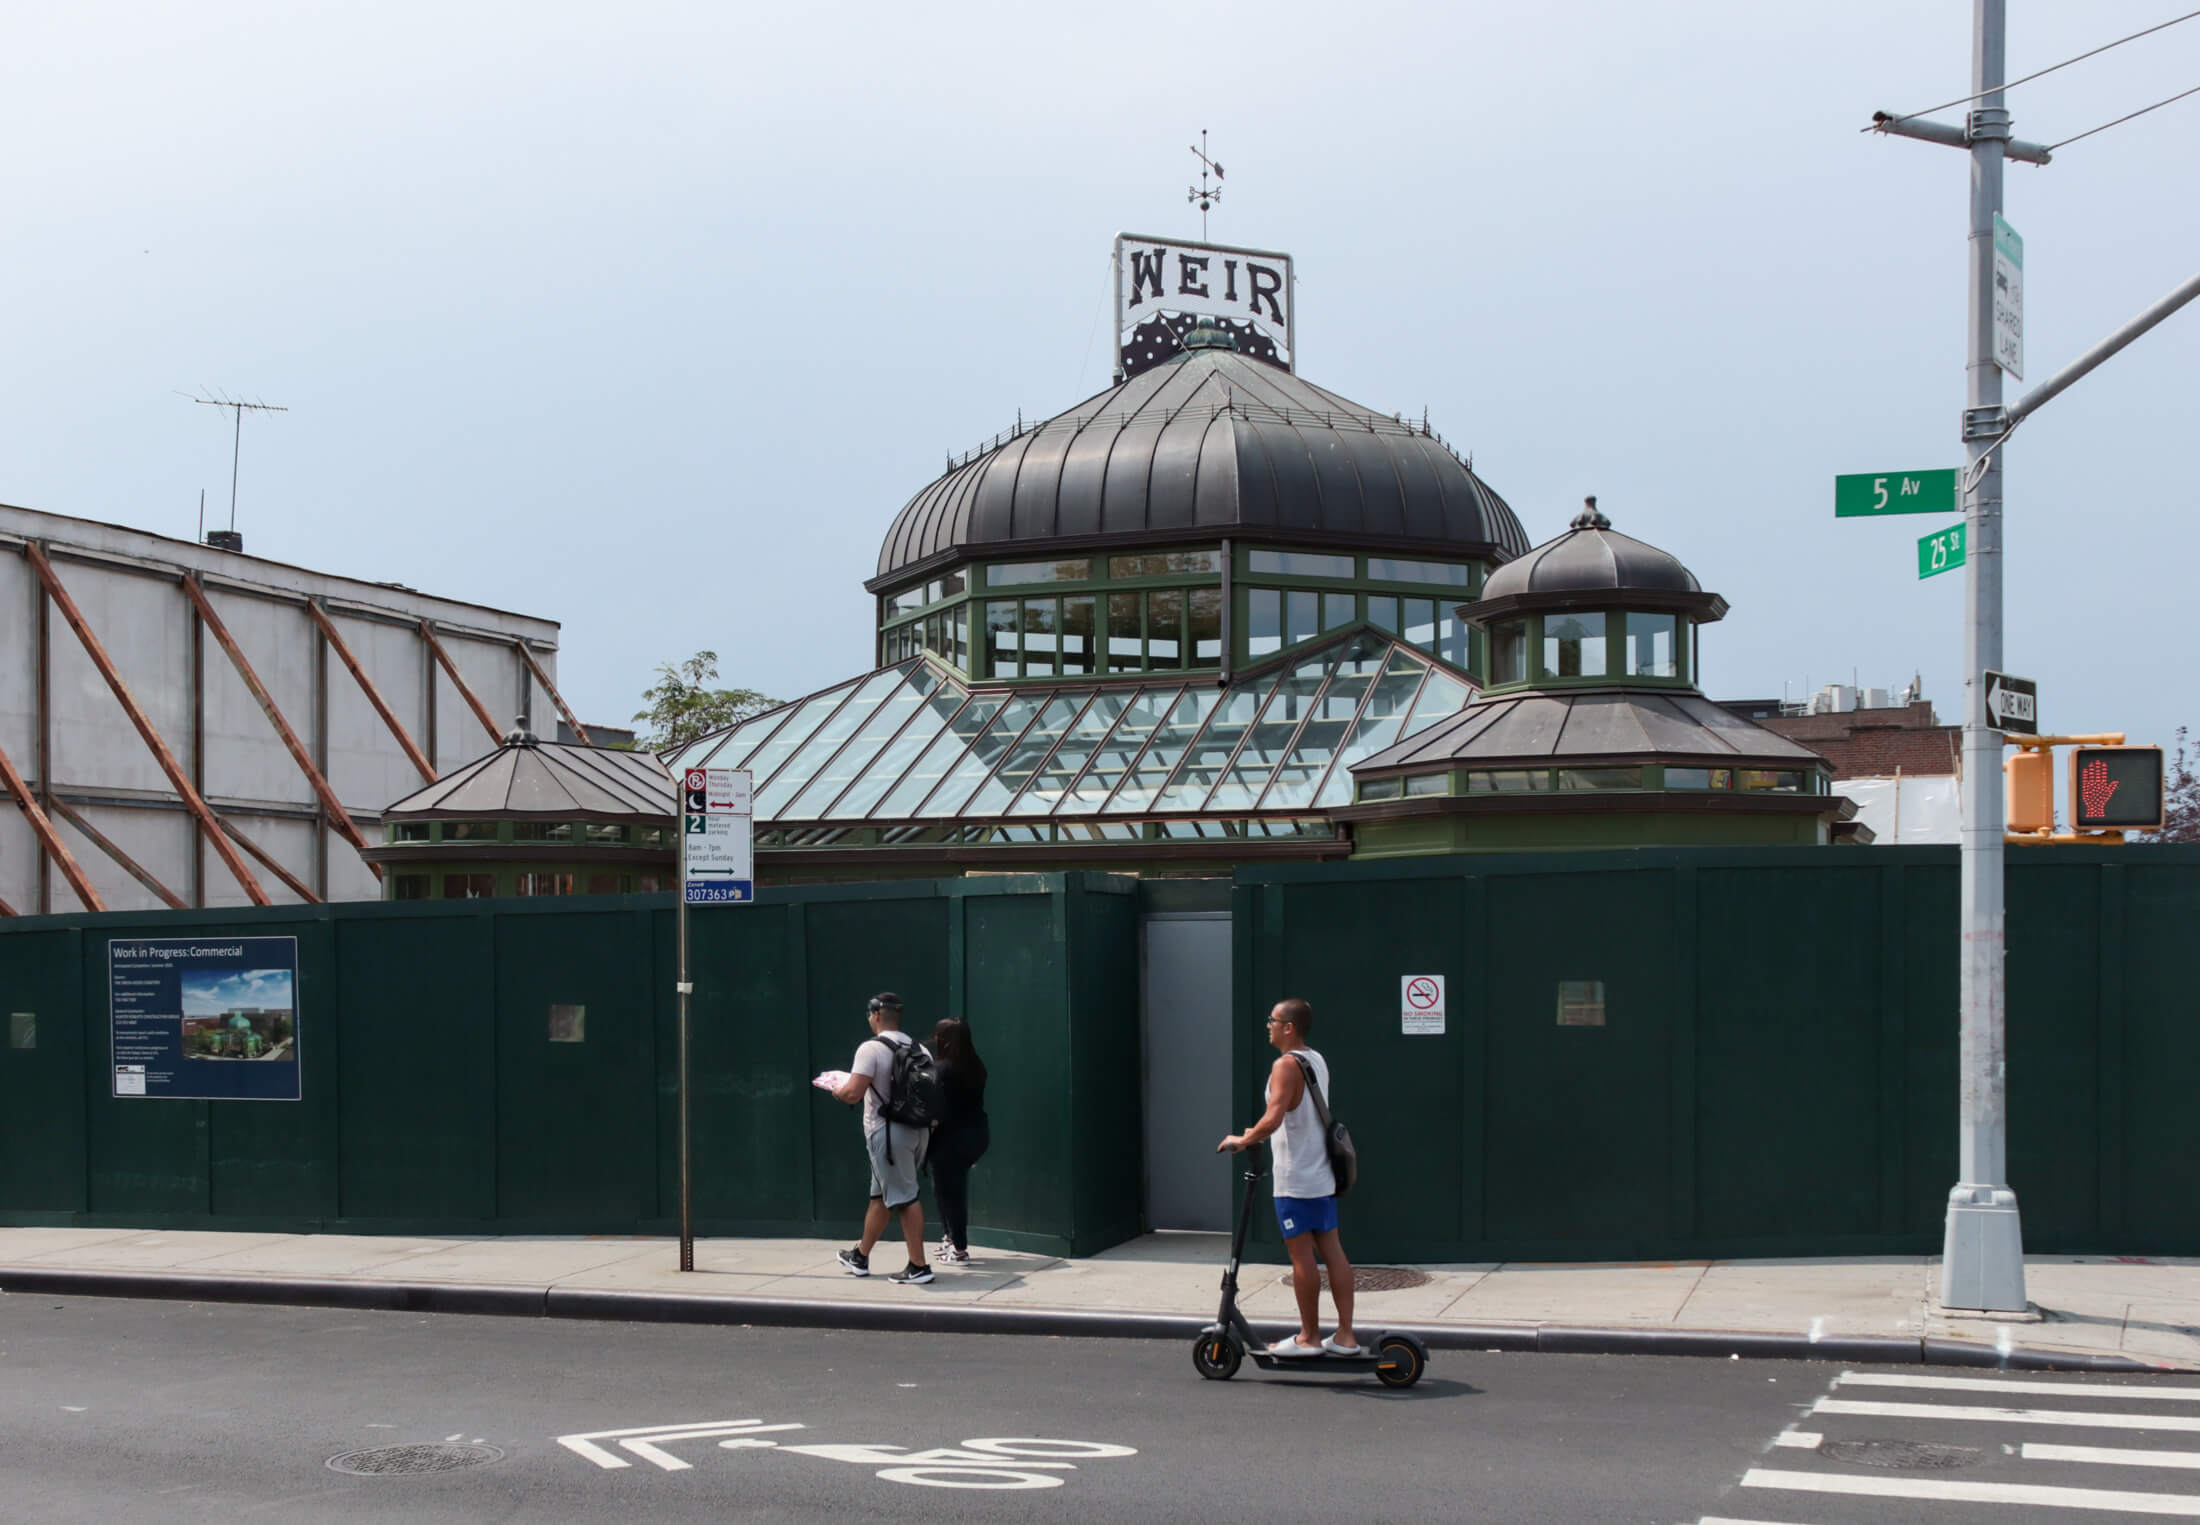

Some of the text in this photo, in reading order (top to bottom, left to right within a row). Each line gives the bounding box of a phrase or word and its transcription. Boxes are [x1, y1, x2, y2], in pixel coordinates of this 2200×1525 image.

[1129, 248, 1285, 327] WEIR
[1873, 477, 1921, 509] 5 Av
[1930, 535, 1947, 570] 25
[2000, 692, 2033, 718] ONE WAY
[690, 815, 701, 833] 2
[688, 854, 734, 863] Except Sunday
[688, 888, 727, 901] 307363
[113, 945, 243, 960] Work in Progress: Commercial
